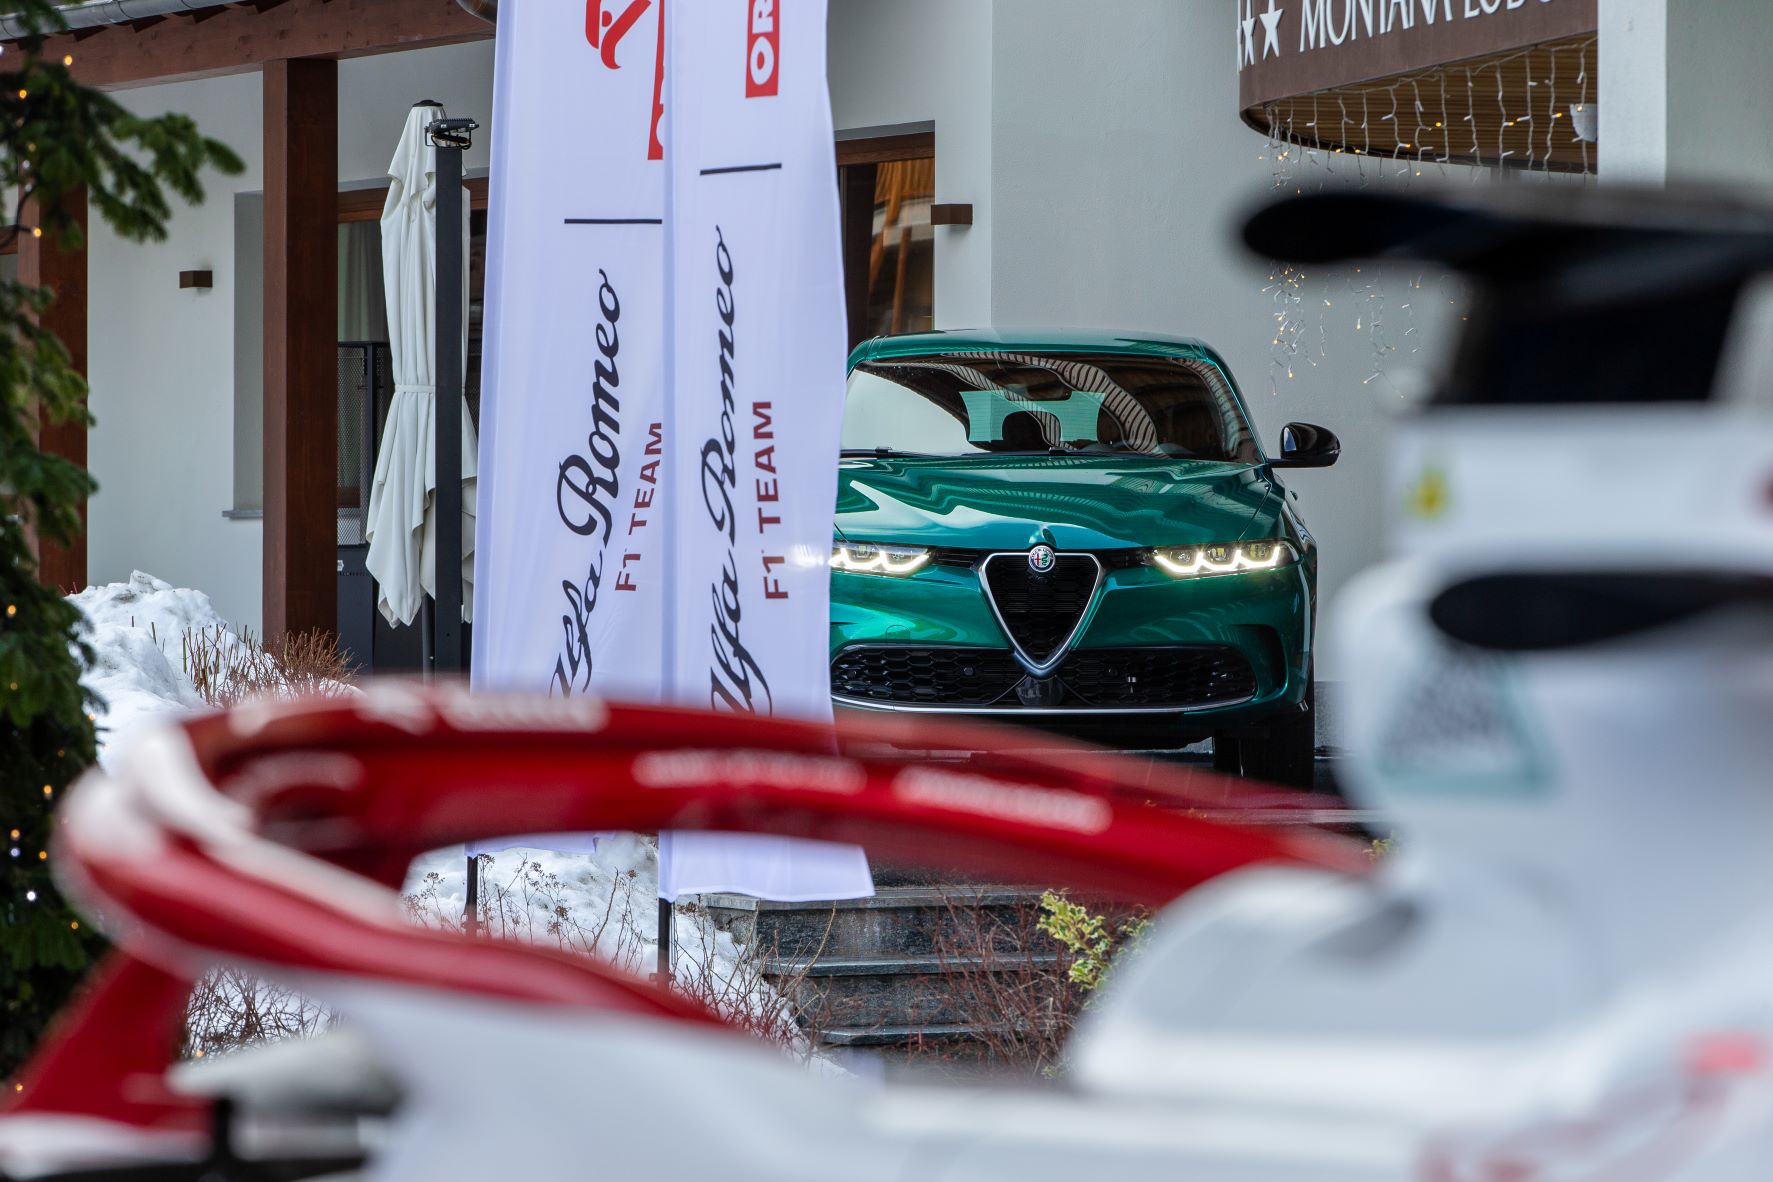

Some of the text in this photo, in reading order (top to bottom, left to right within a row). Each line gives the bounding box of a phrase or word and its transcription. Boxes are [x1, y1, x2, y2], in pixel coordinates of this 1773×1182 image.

[556, 268, 621, 549] Romeo
[701, 224, 736, 547] Romeo
[752, 401, 789, 600] F1 TEAM
[614, 422, 662, 592] F1 TEAM
